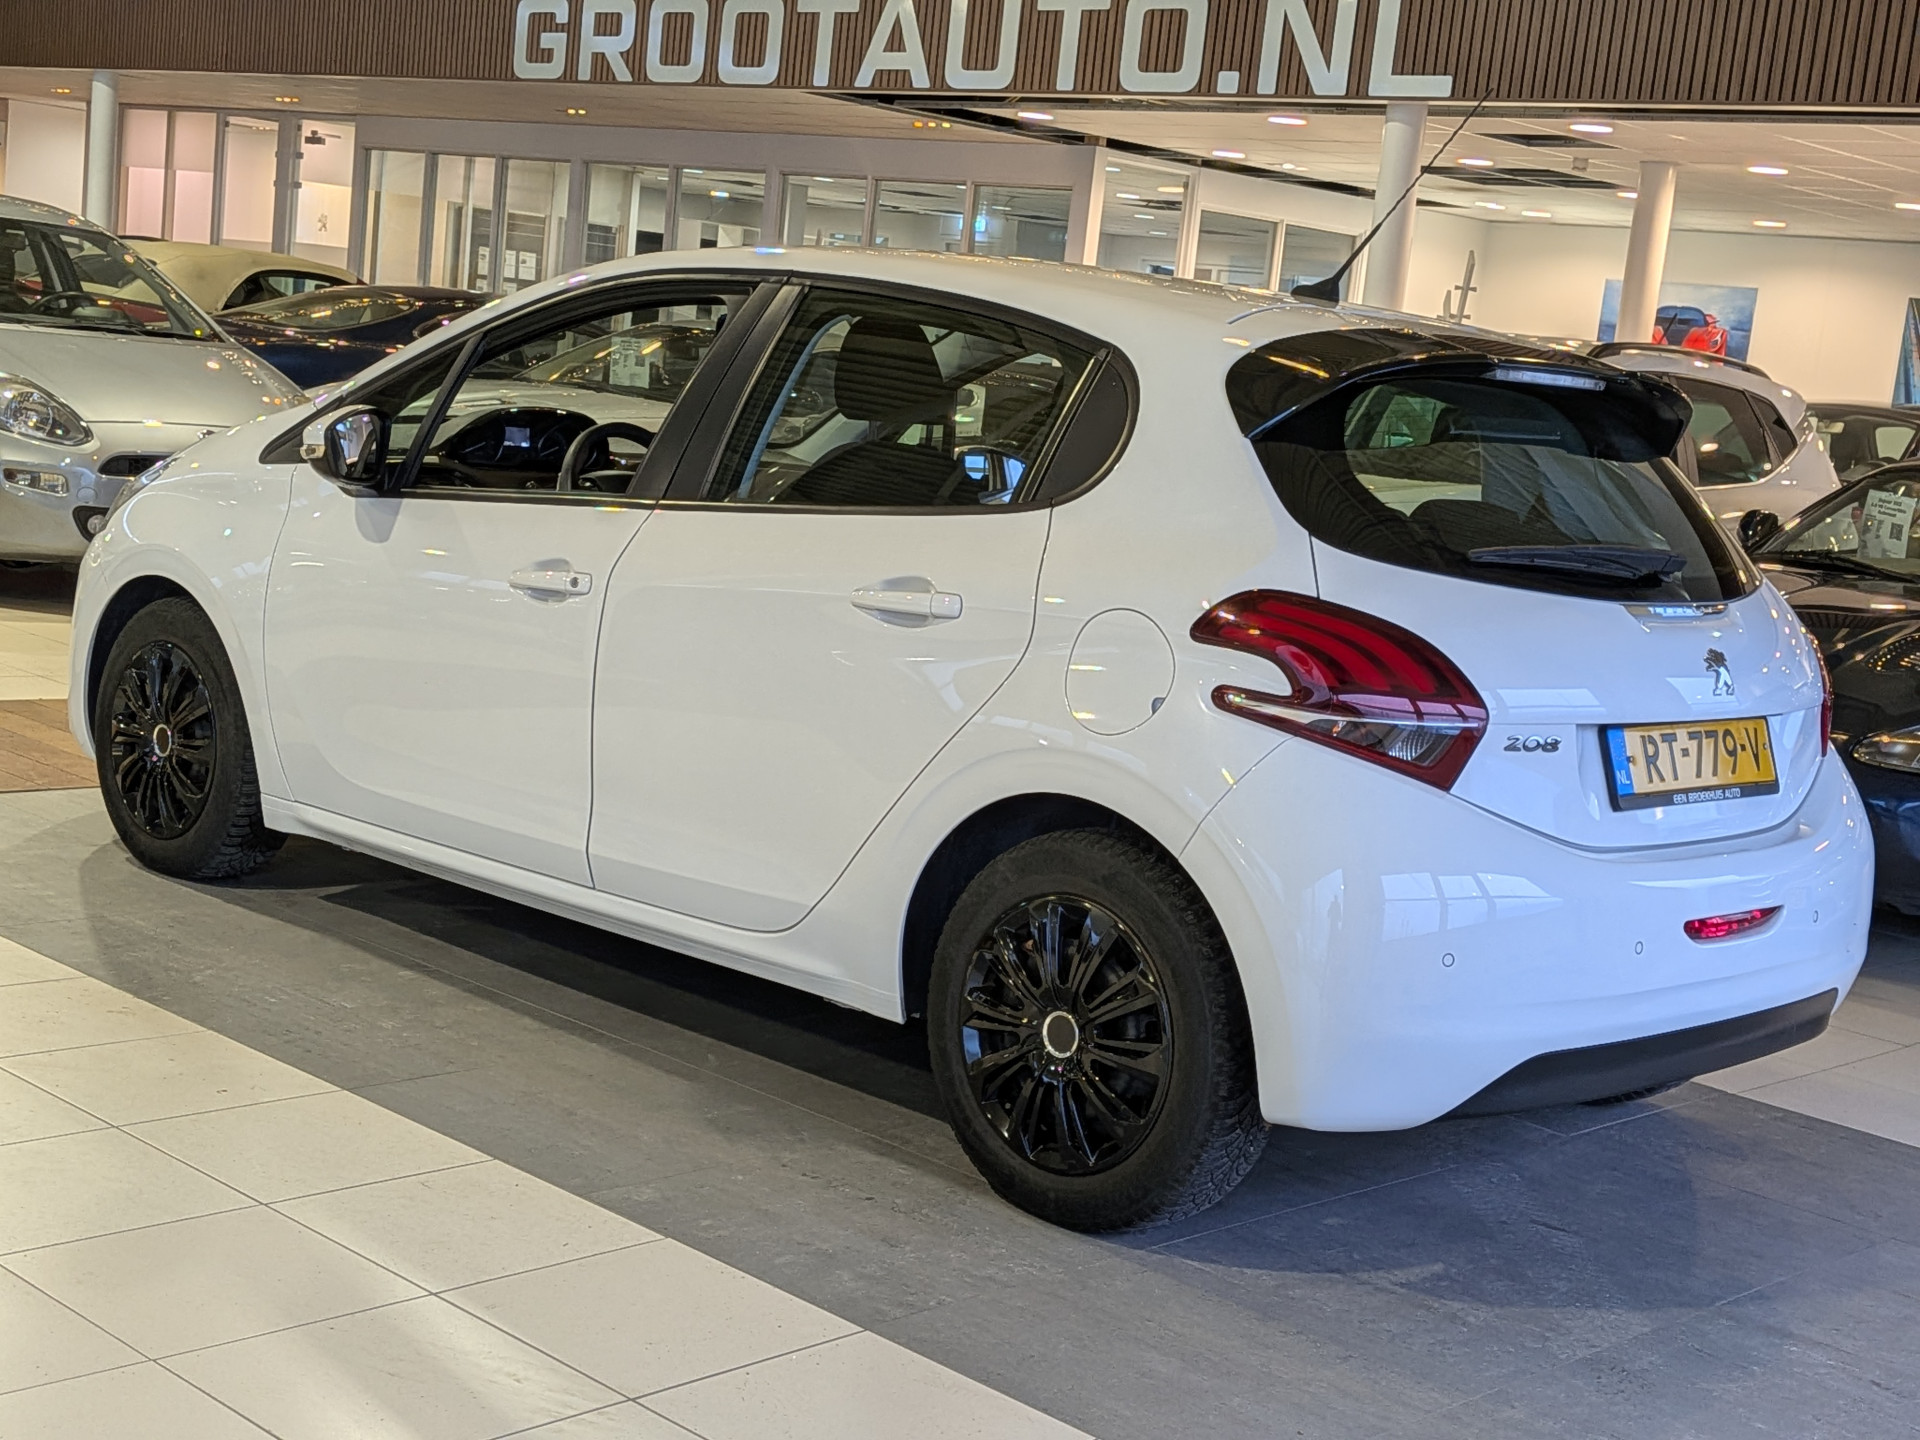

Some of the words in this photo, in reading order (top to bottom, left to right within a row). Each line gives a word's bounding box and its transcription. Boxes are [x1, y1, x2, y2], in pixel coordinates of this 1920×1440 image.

[513, 0, 1453, 97] GROOTAUTO.NL
[1503, 735, 1562, 753] 208
[1640, 727, 1760, 784] RT-779-V
[1616, 769, 1631, 785] NL
[1725, 787, 1741, 799] AUTO
